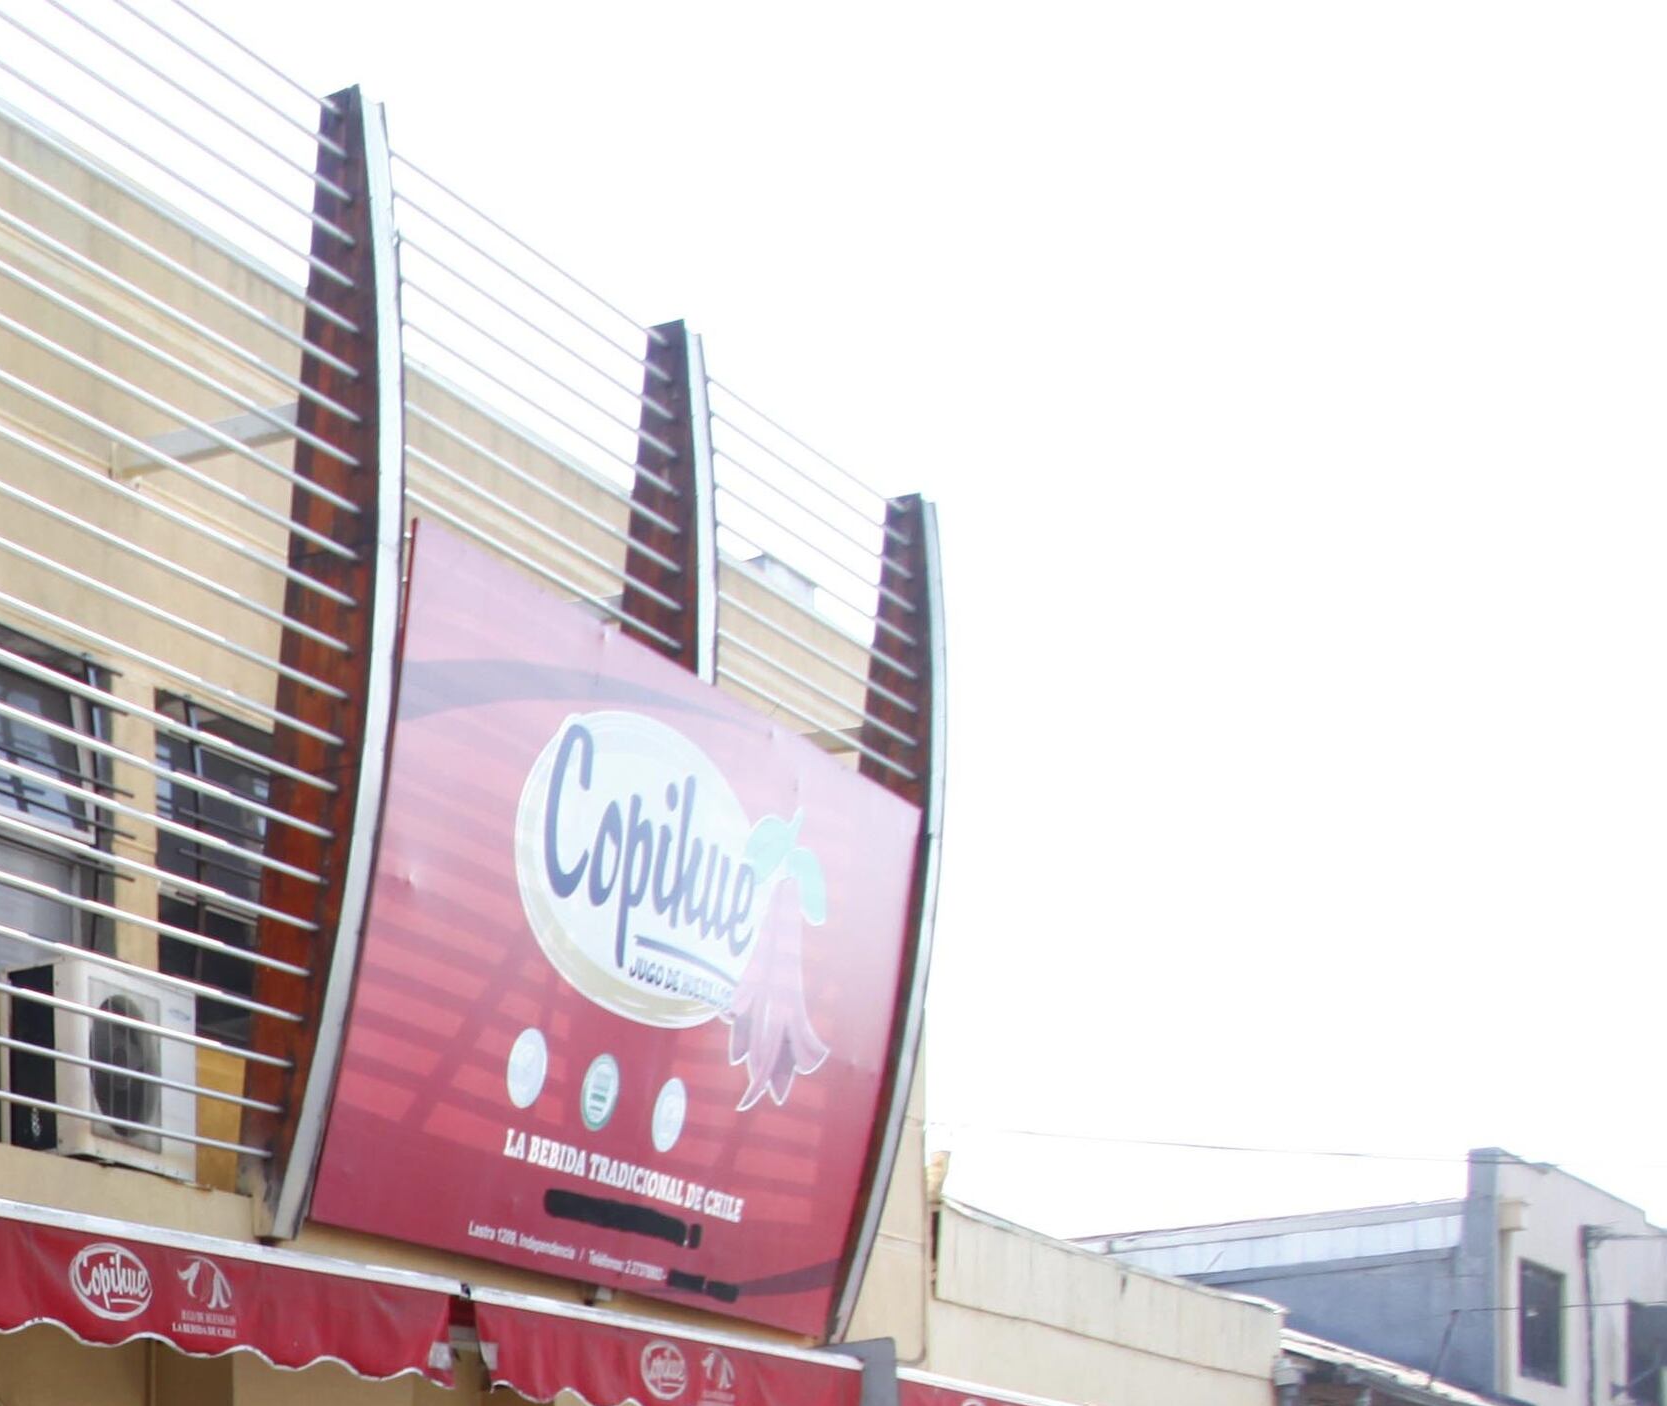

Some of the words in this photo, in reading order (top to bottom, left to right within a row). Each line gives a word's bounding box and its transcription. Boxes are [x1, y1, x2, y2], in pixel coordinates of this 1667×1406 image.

[543, 723, 757, 969] Copihue
[503, 1127, 527, 1160] LA
[527, 1135, 587, 1177] BEBIDA
[587, 1152, 685, 1205] TRADICIONAL
[684, 1182, 704, 1212] DE
[703, 1189, 745, 1224] CHILE
[77, 1251, 152, 1308] Copihue
